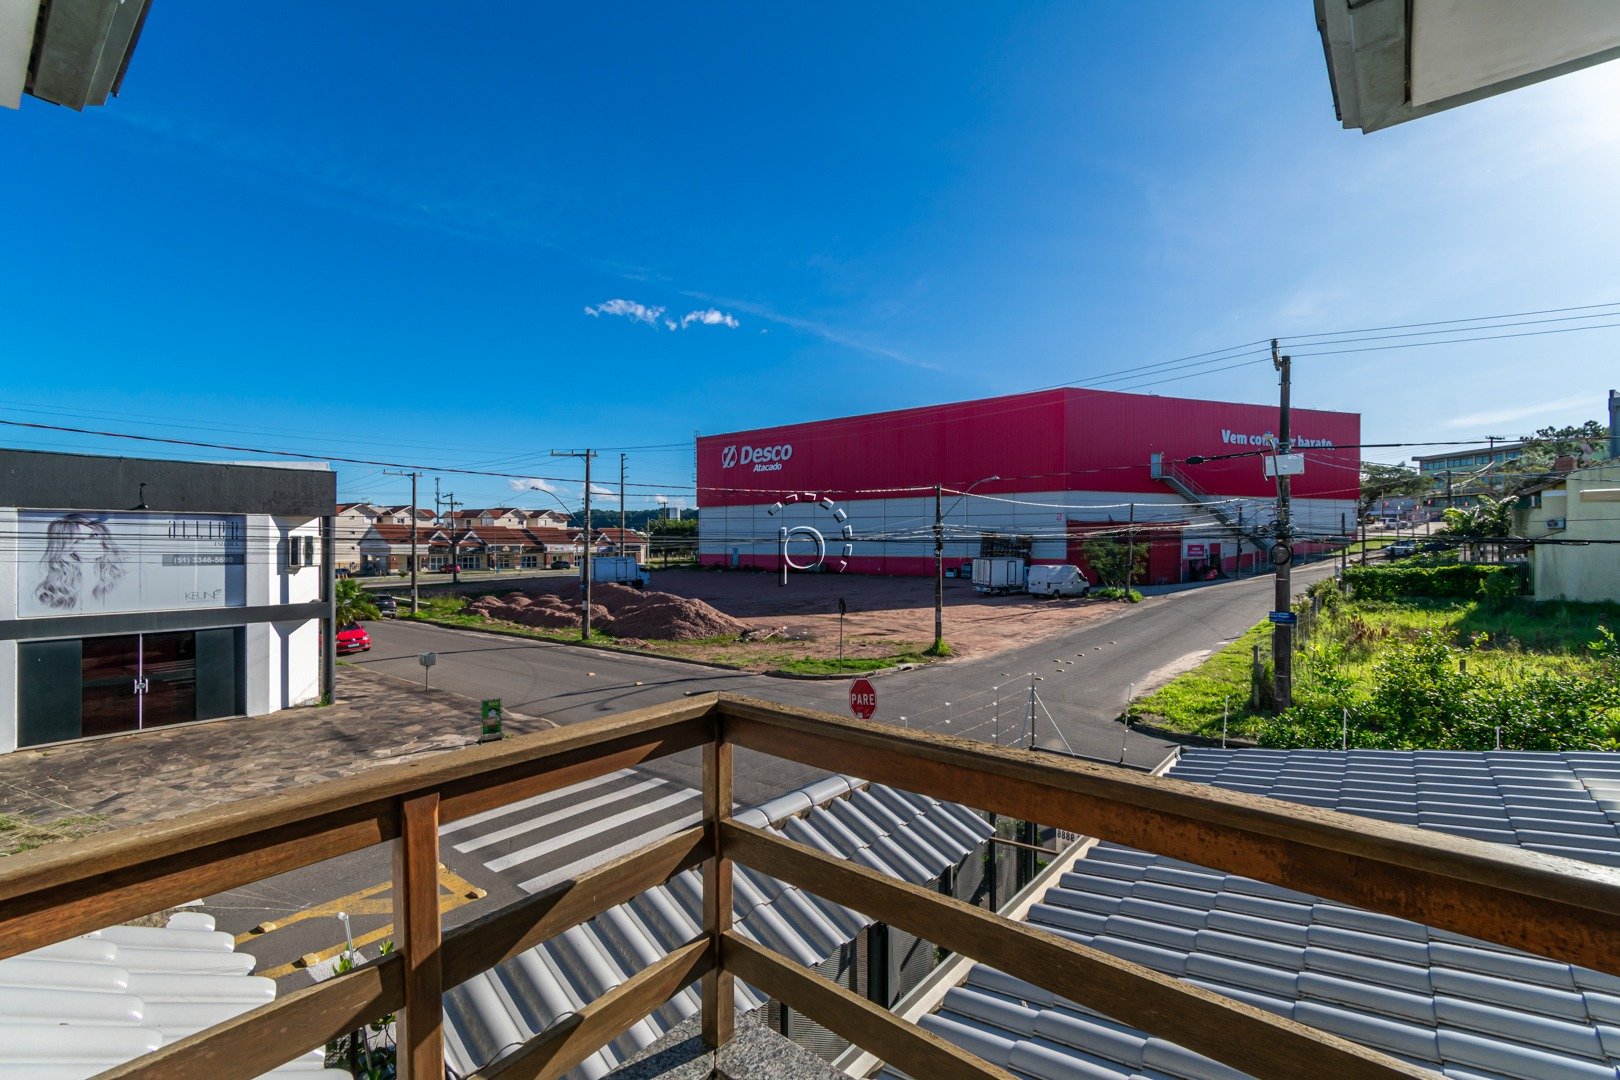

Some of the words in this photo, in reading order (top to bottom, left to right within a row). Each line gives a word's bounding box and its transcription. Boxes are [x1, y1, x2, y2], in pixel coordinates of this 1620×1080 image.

[1222, 429, 1247, 444] Vem
[740, 445, 792, 464] Desco
[753, 462, 781, 472] Atacado
[852, 695, 875, 706] PARE
